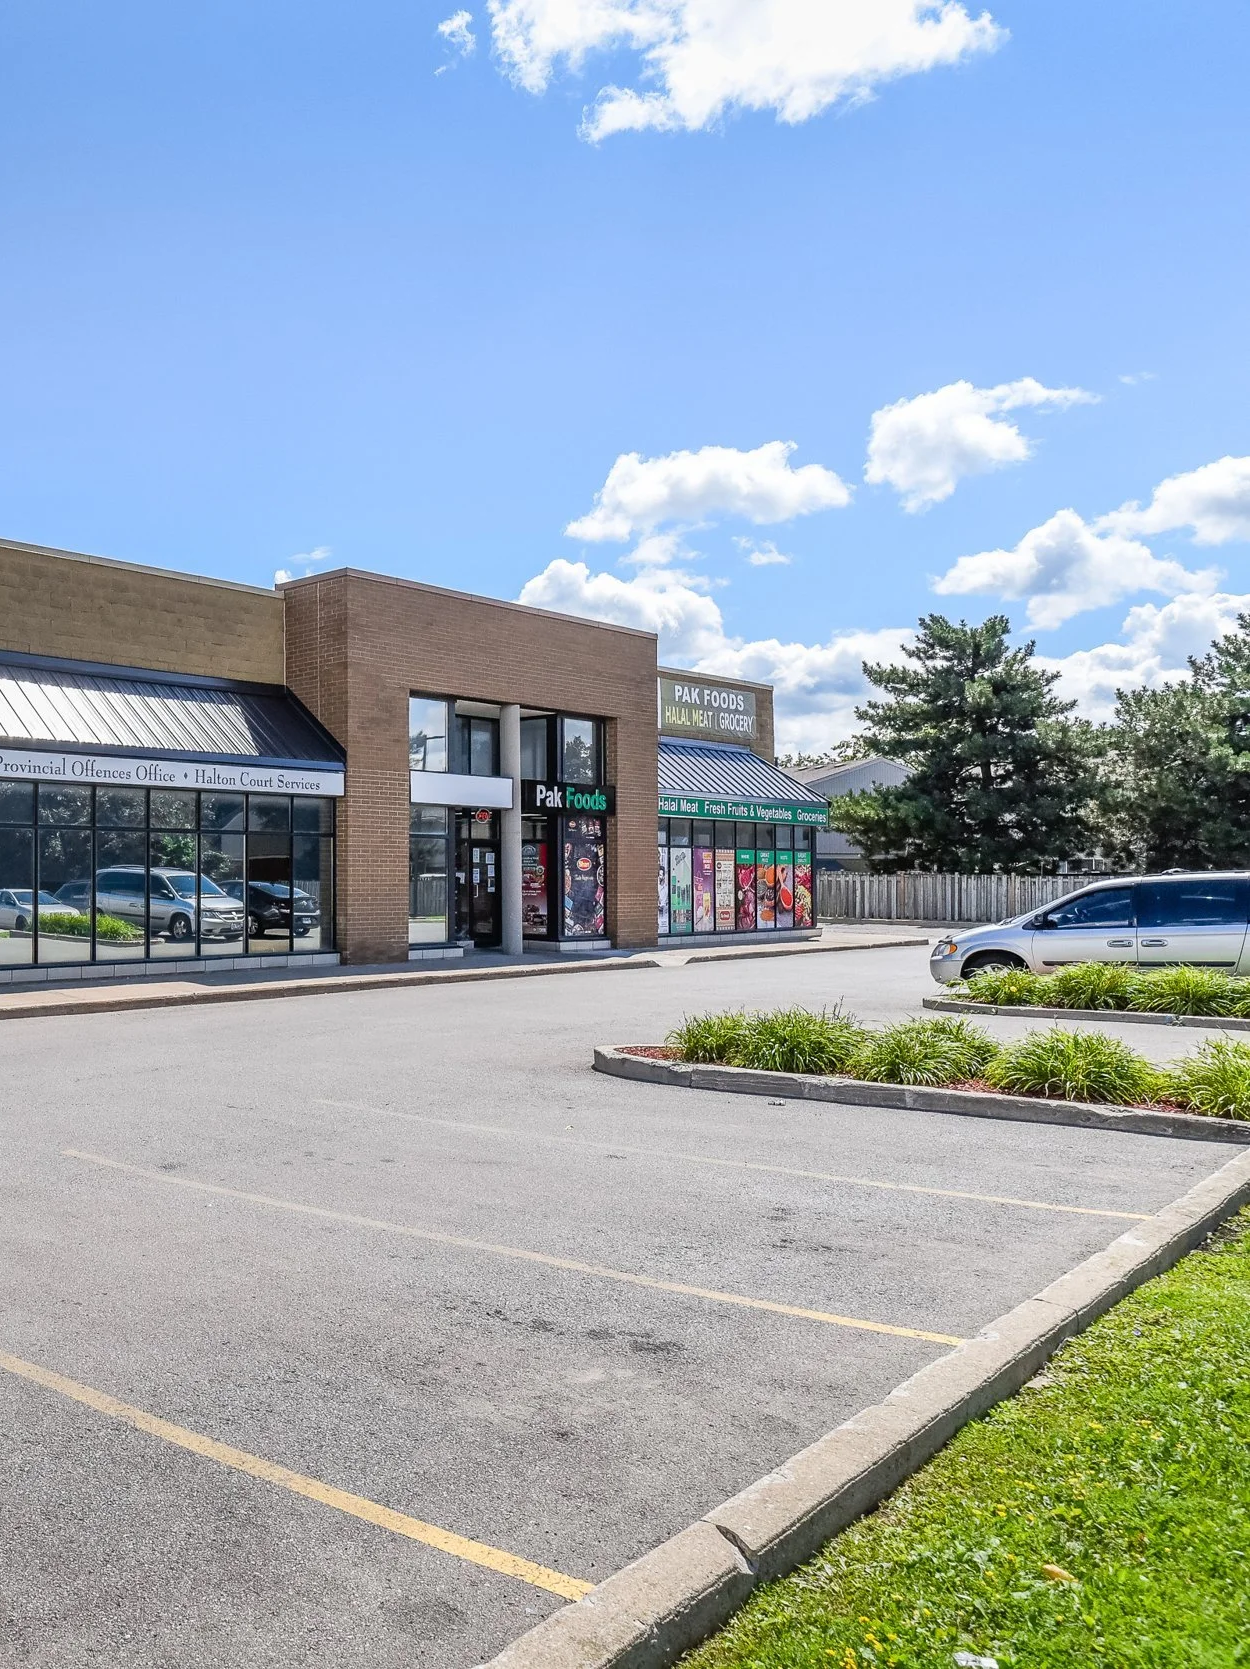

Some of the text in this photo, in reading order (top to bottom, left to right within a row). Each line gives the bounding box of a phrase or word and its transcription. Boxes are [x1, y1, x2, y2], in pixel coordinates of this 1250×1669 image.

[674, 685, 744, 711] PAK FOODS
[665, 706, 690, 725] HALAL
[692, 709, 712, 728] MEAT
[719, 712, 754, 733] GROCERY
[72, 760, 131, 780] Offences
[136, 764, 175, 782] Office
[195, 768, 236, 786] Halton
[240, 772, 273, 788] Court
[277, 774, 321, 790] Services
[536, 785, 607, 810] Pak Foods
[658, 797, 827, 822] Halal Meat Fresh Fruits & Vegetables Groceries
